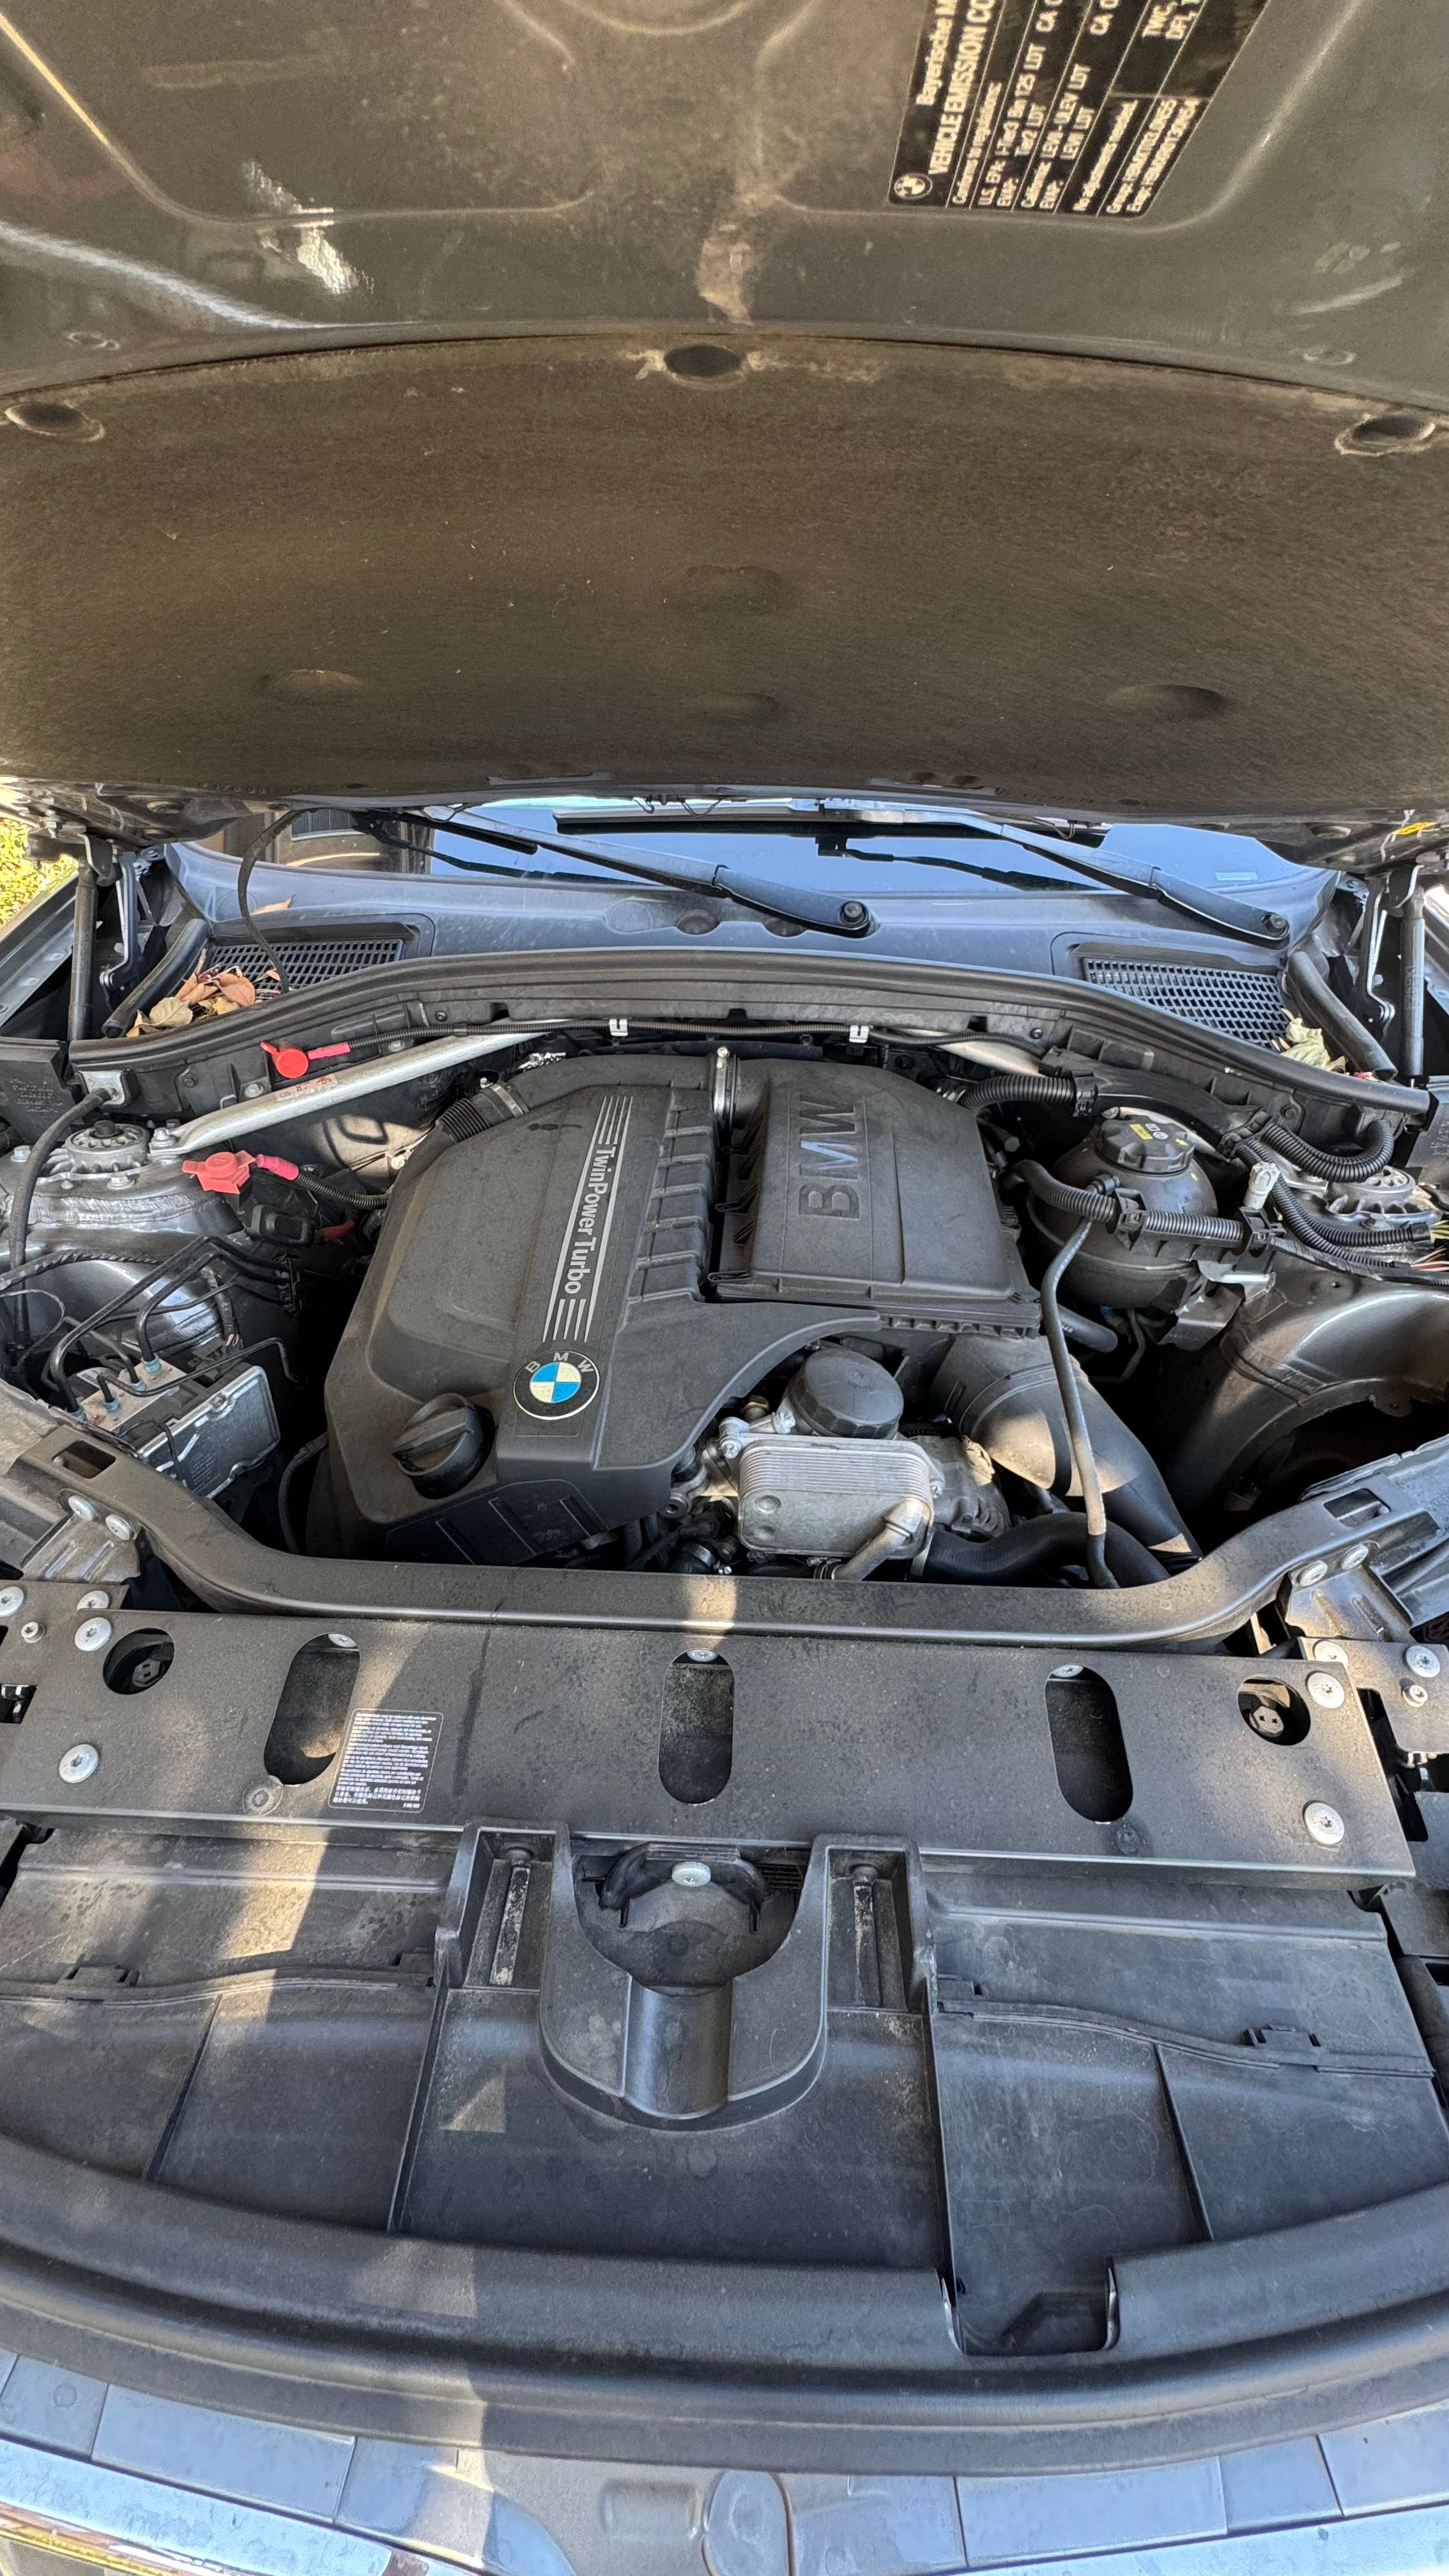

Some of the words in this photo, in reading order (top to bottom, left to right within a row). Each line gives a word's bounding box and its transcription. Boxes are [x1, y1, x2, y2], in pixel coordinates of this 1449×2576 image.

[1035, 10, 1058, 33] CA
[1141, 0, 1177, 37] TWC,
[915, 17, 953, 105] Bayerische
[943, 26, 986, 113] EMISSION
[1023, 42, 1046, 70] LDT
[1014, 73, 1036, 97] 125
[1020, 161, 1052, 208] California:
[1053, 91, 1078, 125] ULEV
[1067, 63, 1091, 90] LDT
[1089, 13, 1113, 35] CA
[1025, 102, 1046, 127] LDT
[928, 114, 963, 174] VEHICLE
[1014, 128, 1038, 157] Tier2
[1038, 180, 1064, 209] EVAP:
[1073, 106, 1094, 130] LDT
[1072, 197, 1090, 211] No
[1107, 99, 1138, 143] needed.
[951, 158, 978, 204] Conforms
[985, 160, 1006, 183] EPA:
[996, 177, 1019, 206] EVAP:
[1105, 181, 1133, 213] Group:
[1126, 185, 1152, 212] Evap:
[799, 1094, 861, 1221] BMW
[525, 1352, 594, 1374] BMW
